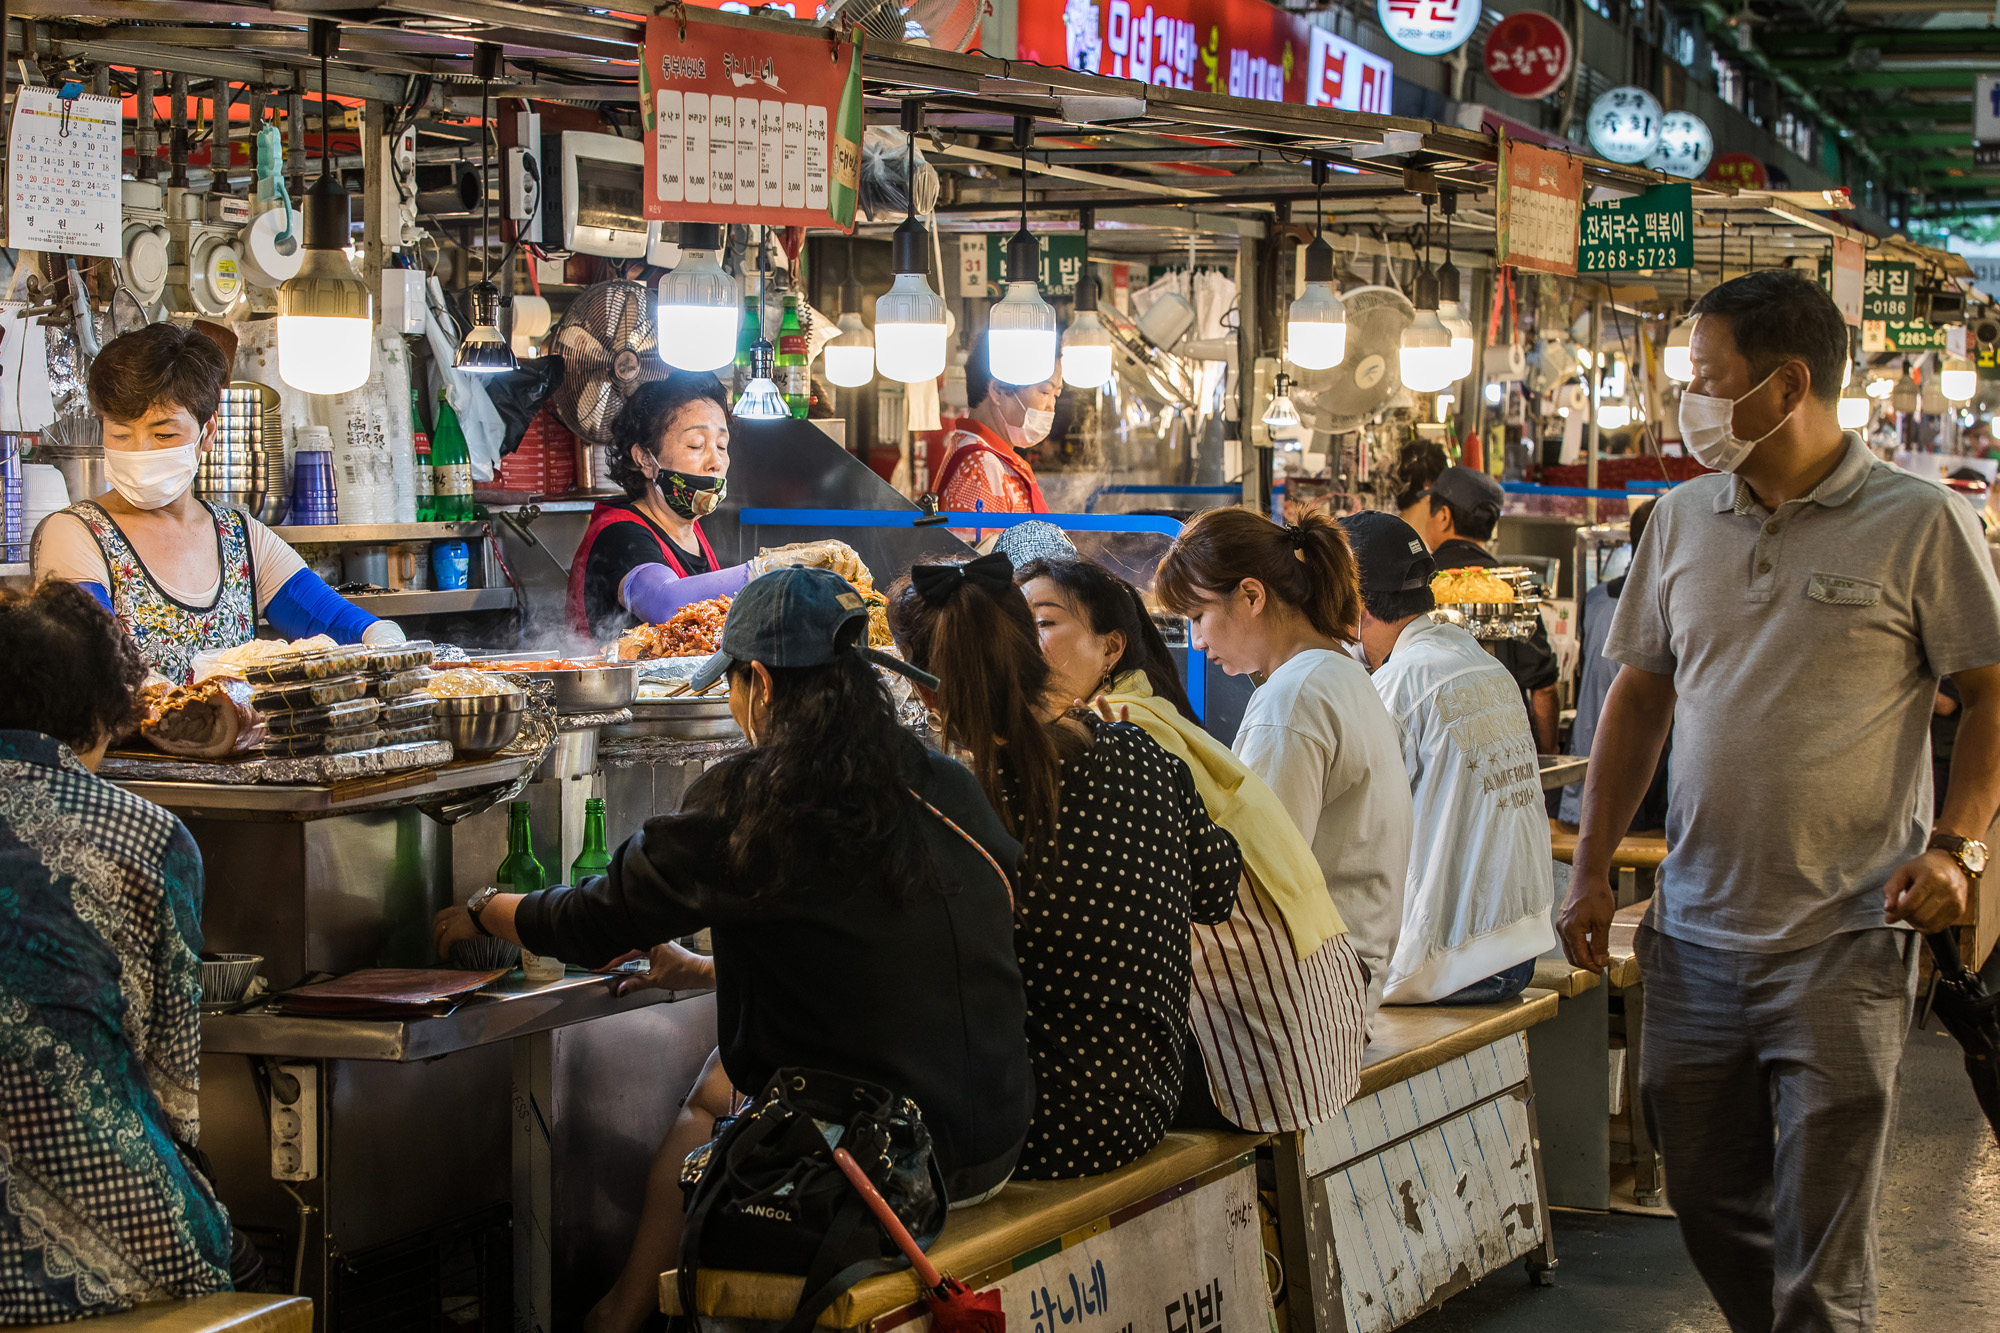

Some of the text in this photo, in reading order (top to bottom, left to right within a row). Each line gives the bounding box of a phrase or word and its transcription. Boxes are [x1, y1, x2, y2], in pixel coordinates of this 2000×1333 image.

[723, 53, 773, 80] 하니네
[17, 154, 23, 162] 12
[662, 174, 679, 184] 15,000
[689, 176, 705, 186] 10,000
[718, 172, 734, 181] 10,000
[102, 183, 110, 191] 25
[720, 183, 733, 192] 6,000
[740, 179, 755, 188] 10,000
[764, 182, 778, 190] 5,000
[788, 183, 800, 192] 3,000
[811, 185, 823, 193] 3,000
[17, 193, 24, 201] 26
[43, 196, 49, 204] 28
[58, 219, 66, 230] 원
[95, 223, 104, 233] 사
[965, 260, 980, 272] 31
[1483, 762, 1536, 795] AMERICAN
[741, 1204, 792, 1222] ANGOL
